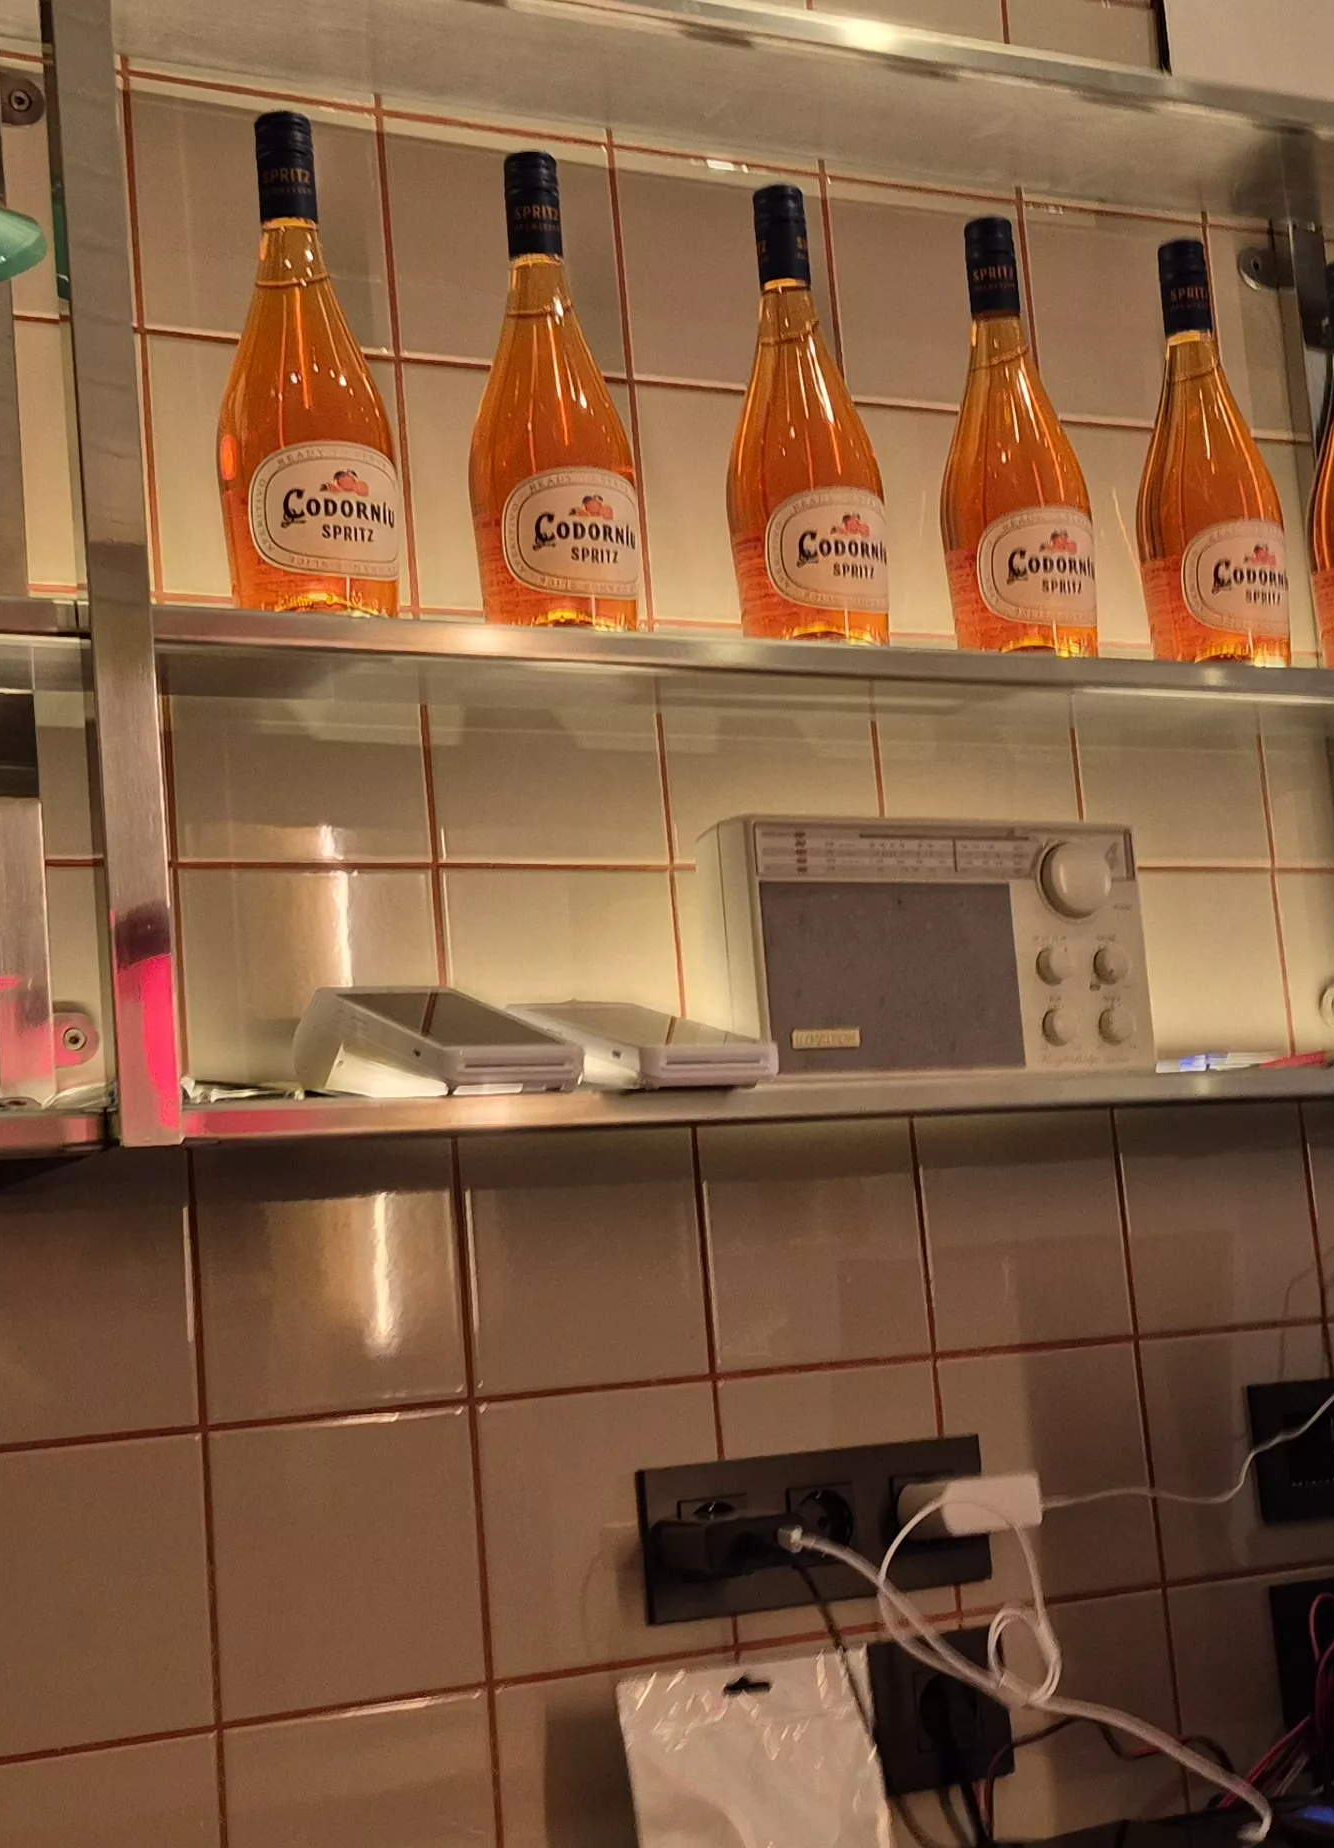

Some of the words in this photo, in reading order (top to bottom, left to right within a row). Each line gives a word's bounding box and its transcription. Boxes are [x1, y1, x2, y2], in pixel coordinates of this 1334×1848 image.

[262, 167, 312, 184] SPRITZ
[515, 205, 560, 221] SPRITZ
[321, 523, 375, 543] SPRITZ
[571, 546, 619, 564] SPRITZ
[833, 563, 875, 580] SPRITZ
